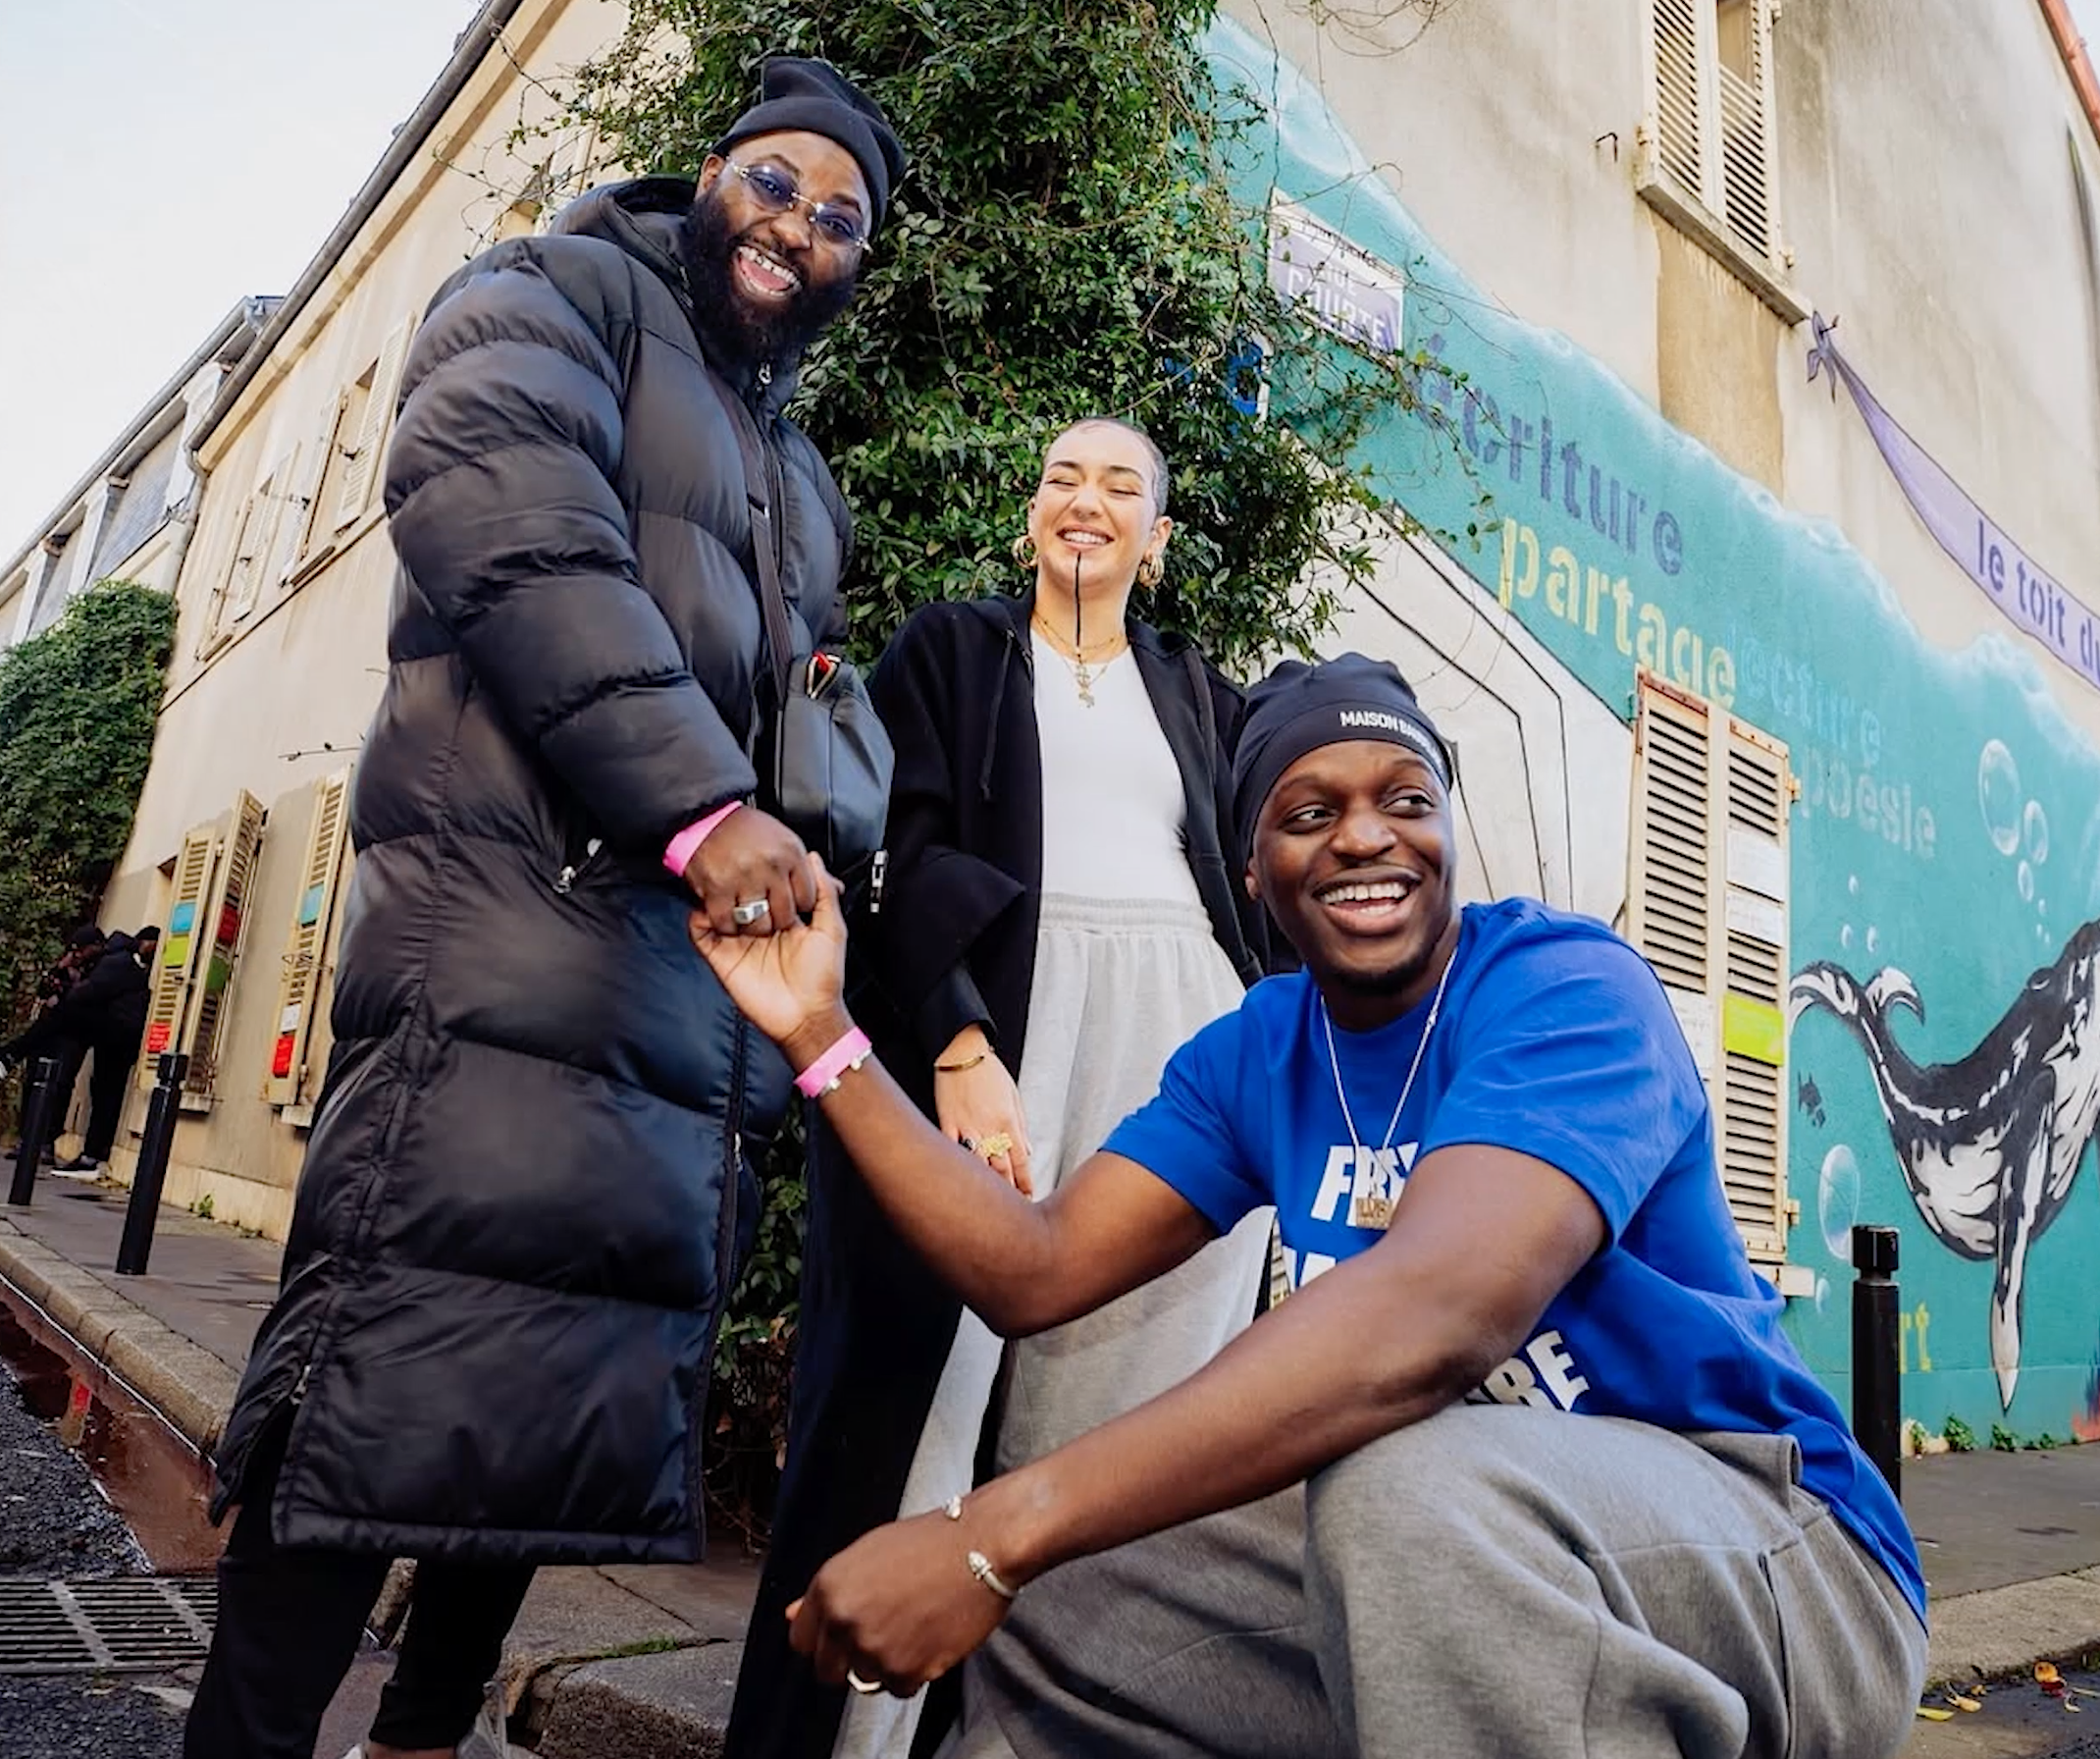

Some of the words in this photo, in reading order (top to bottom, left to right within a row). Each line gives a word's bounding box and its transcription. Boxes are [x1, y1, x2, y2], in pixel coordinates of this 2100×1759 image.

[1978, 517, 2004, 592] le
[2017, 560, 2065, 648] toit
[1339, 711, 1398, 731] MAISON
[1464, 1329, 1590, 1412] RE
